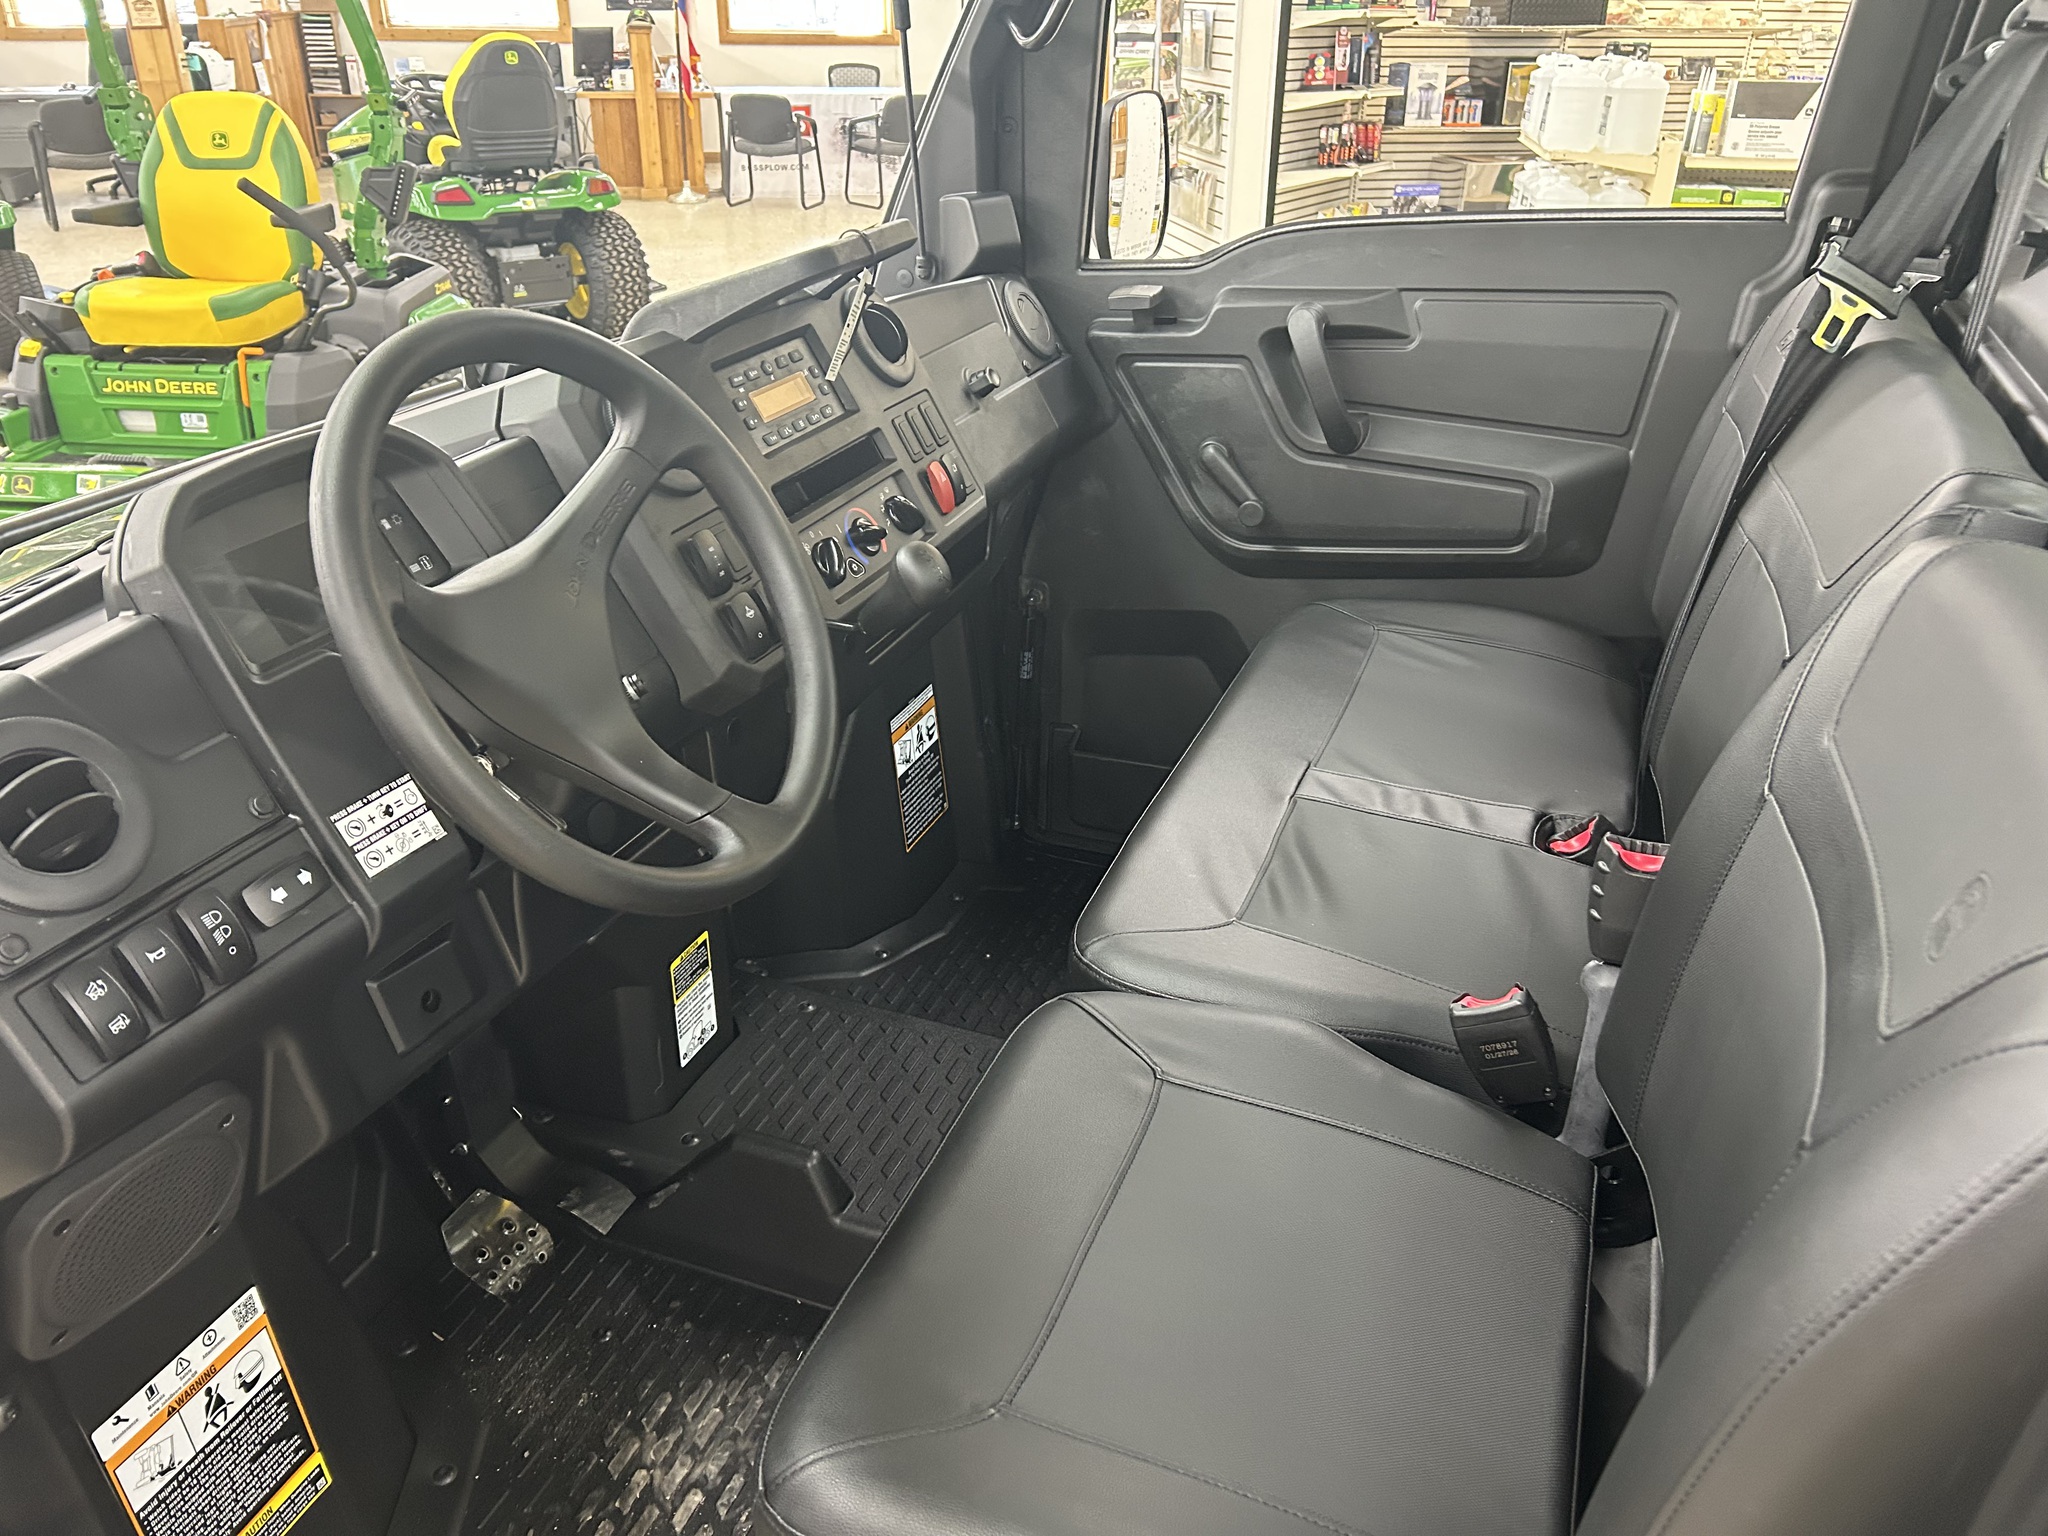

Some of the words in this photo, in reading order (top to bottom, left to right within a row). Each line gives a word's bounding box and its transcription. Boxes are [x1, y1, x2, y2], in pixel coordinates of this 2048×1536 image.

[741, 164, 809, 172] BSSPLOW.COM
[102, 378, 151, 393] JOHN
[154, 379, 219, 395] DEERE
[579, 478, 638, 551] DEERE
[329, 808, 348, 822] PRESS
[345, 799, 364, 813] BRAKE
[366, 790, 381, 802] TURN
[379, 784, 391, 794] KEY
[389, 781, 397, 789] TO
[395, 773, 411, 785] START
[352, 838, 370, 852] PRESS
[368, 828, 387, 843] BRAKE
[389, 820, 400, 830] KEY
[398, 816, 408, 825] ON
[406, 812, 414, 820] TO
[413, 804, 427, 817] SHIFT
[1480, 1040, 1518, 1052] 7078917
[174, 1362, 217, 1408] WARNING
[138, 1496, 158, 1519] Avoid
[157, 1477, 178, 1502] Injury
[177, 1471, 186, 1482] or
[184, 1450, 205, 1473] Death
[204, 1435, 220, 1454] from
[219, 1410, 245, 1439] Rollover
[245, 1404, 253, 1414] or
[251, 1382, 273, 1407] Falling
[272, 1372, 282, 1386] Off
[245, 1505, 273, 1536] AUTION
